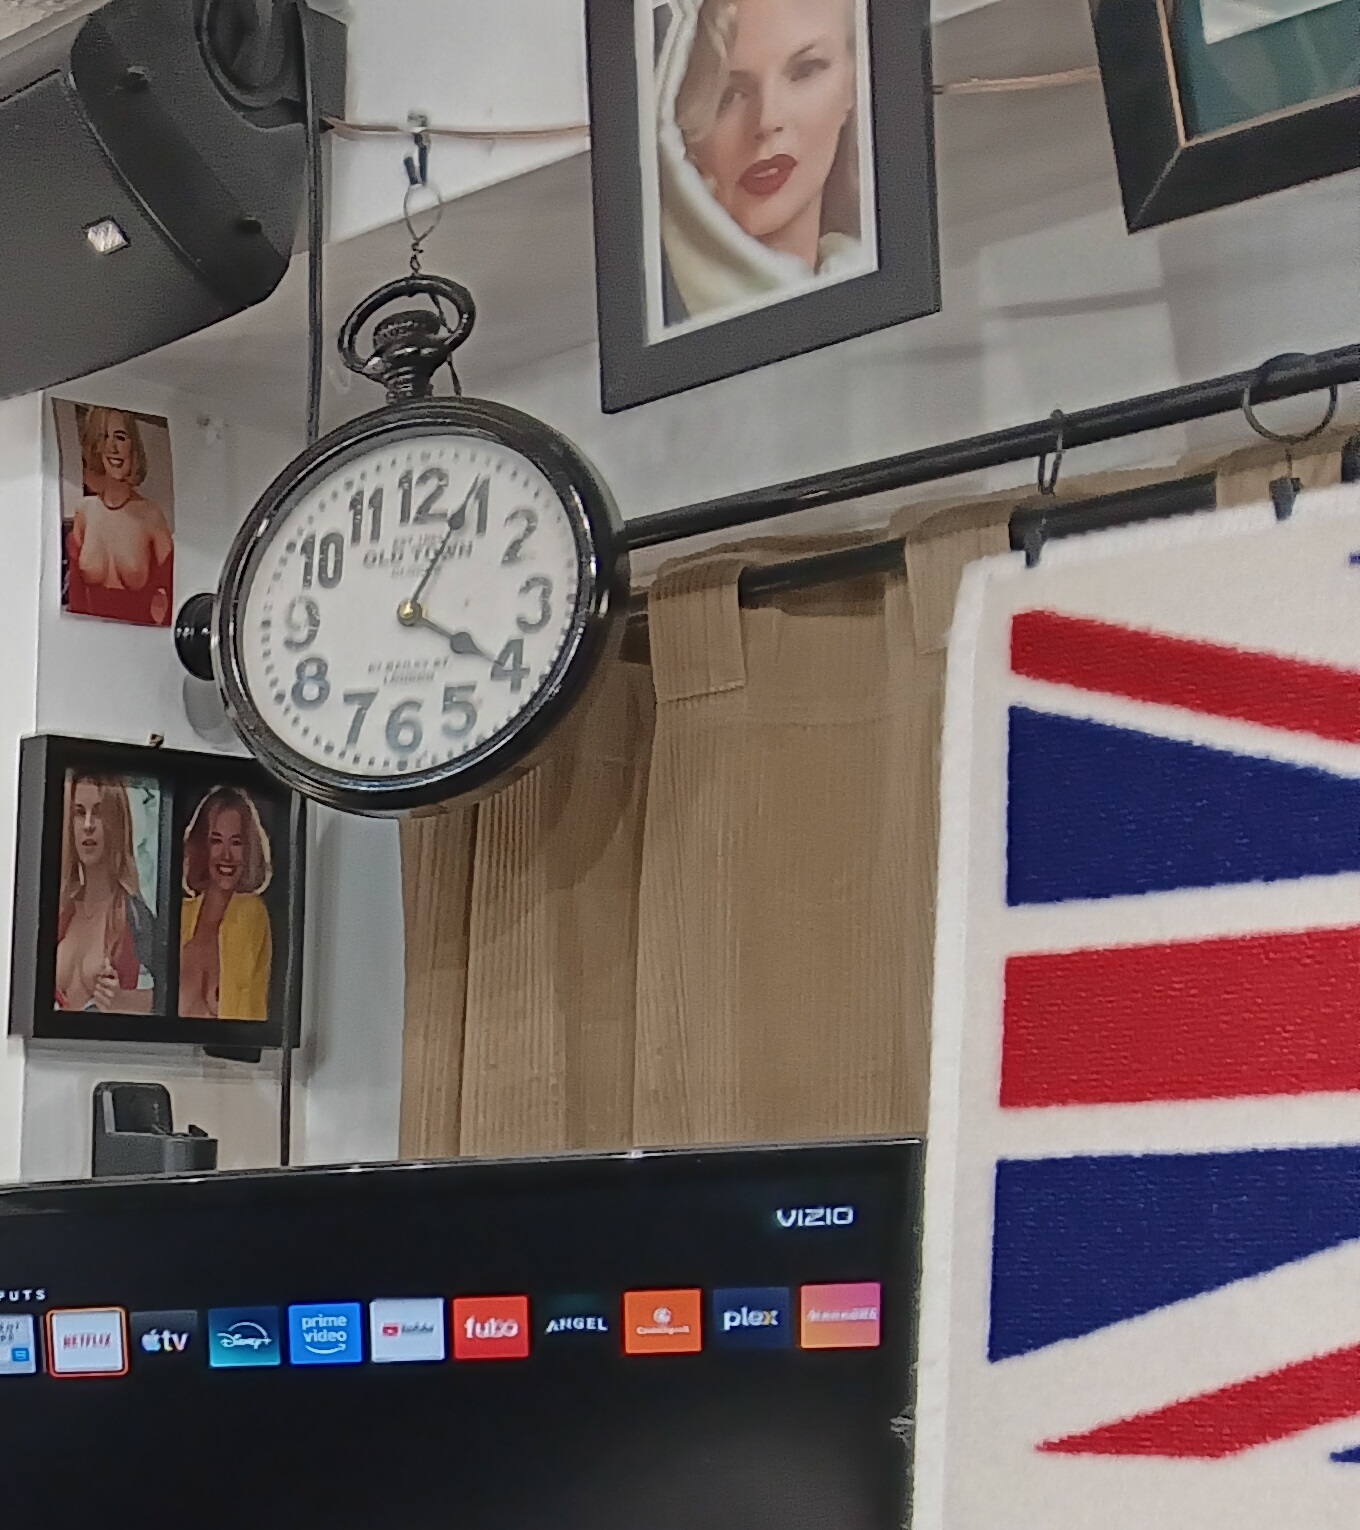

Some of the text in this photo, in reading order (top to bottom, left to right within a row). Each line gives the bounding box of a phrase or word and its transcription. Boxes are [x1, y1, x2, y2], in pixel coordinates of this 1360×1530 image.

[349, 487, 384, 545] 11
[398, 467, 449, 525] 12
[300, 532, 345, 590] 10
[500, 509, 539, 567] 2
[283, 594, 320, 651] 9
[516, 577, 553, 633] 3
[290, 657, 330, 710] 8
[490, 638, 530, 692] 4
[343, 688, 378, 749] 7
[385, 700, 423, 755] 6
[441, 682, 477, 737] 5
[776, 1206, 854, 1228] VIZIO
[62, 1331, 113, 1350] NETFLIX
[302, 1313, 347, 1330] prime
[303, 1329, 347, 1344] video
[543, 1317, 609, 1336] ANGEL
[724, 1306, 779, 1331] plex
